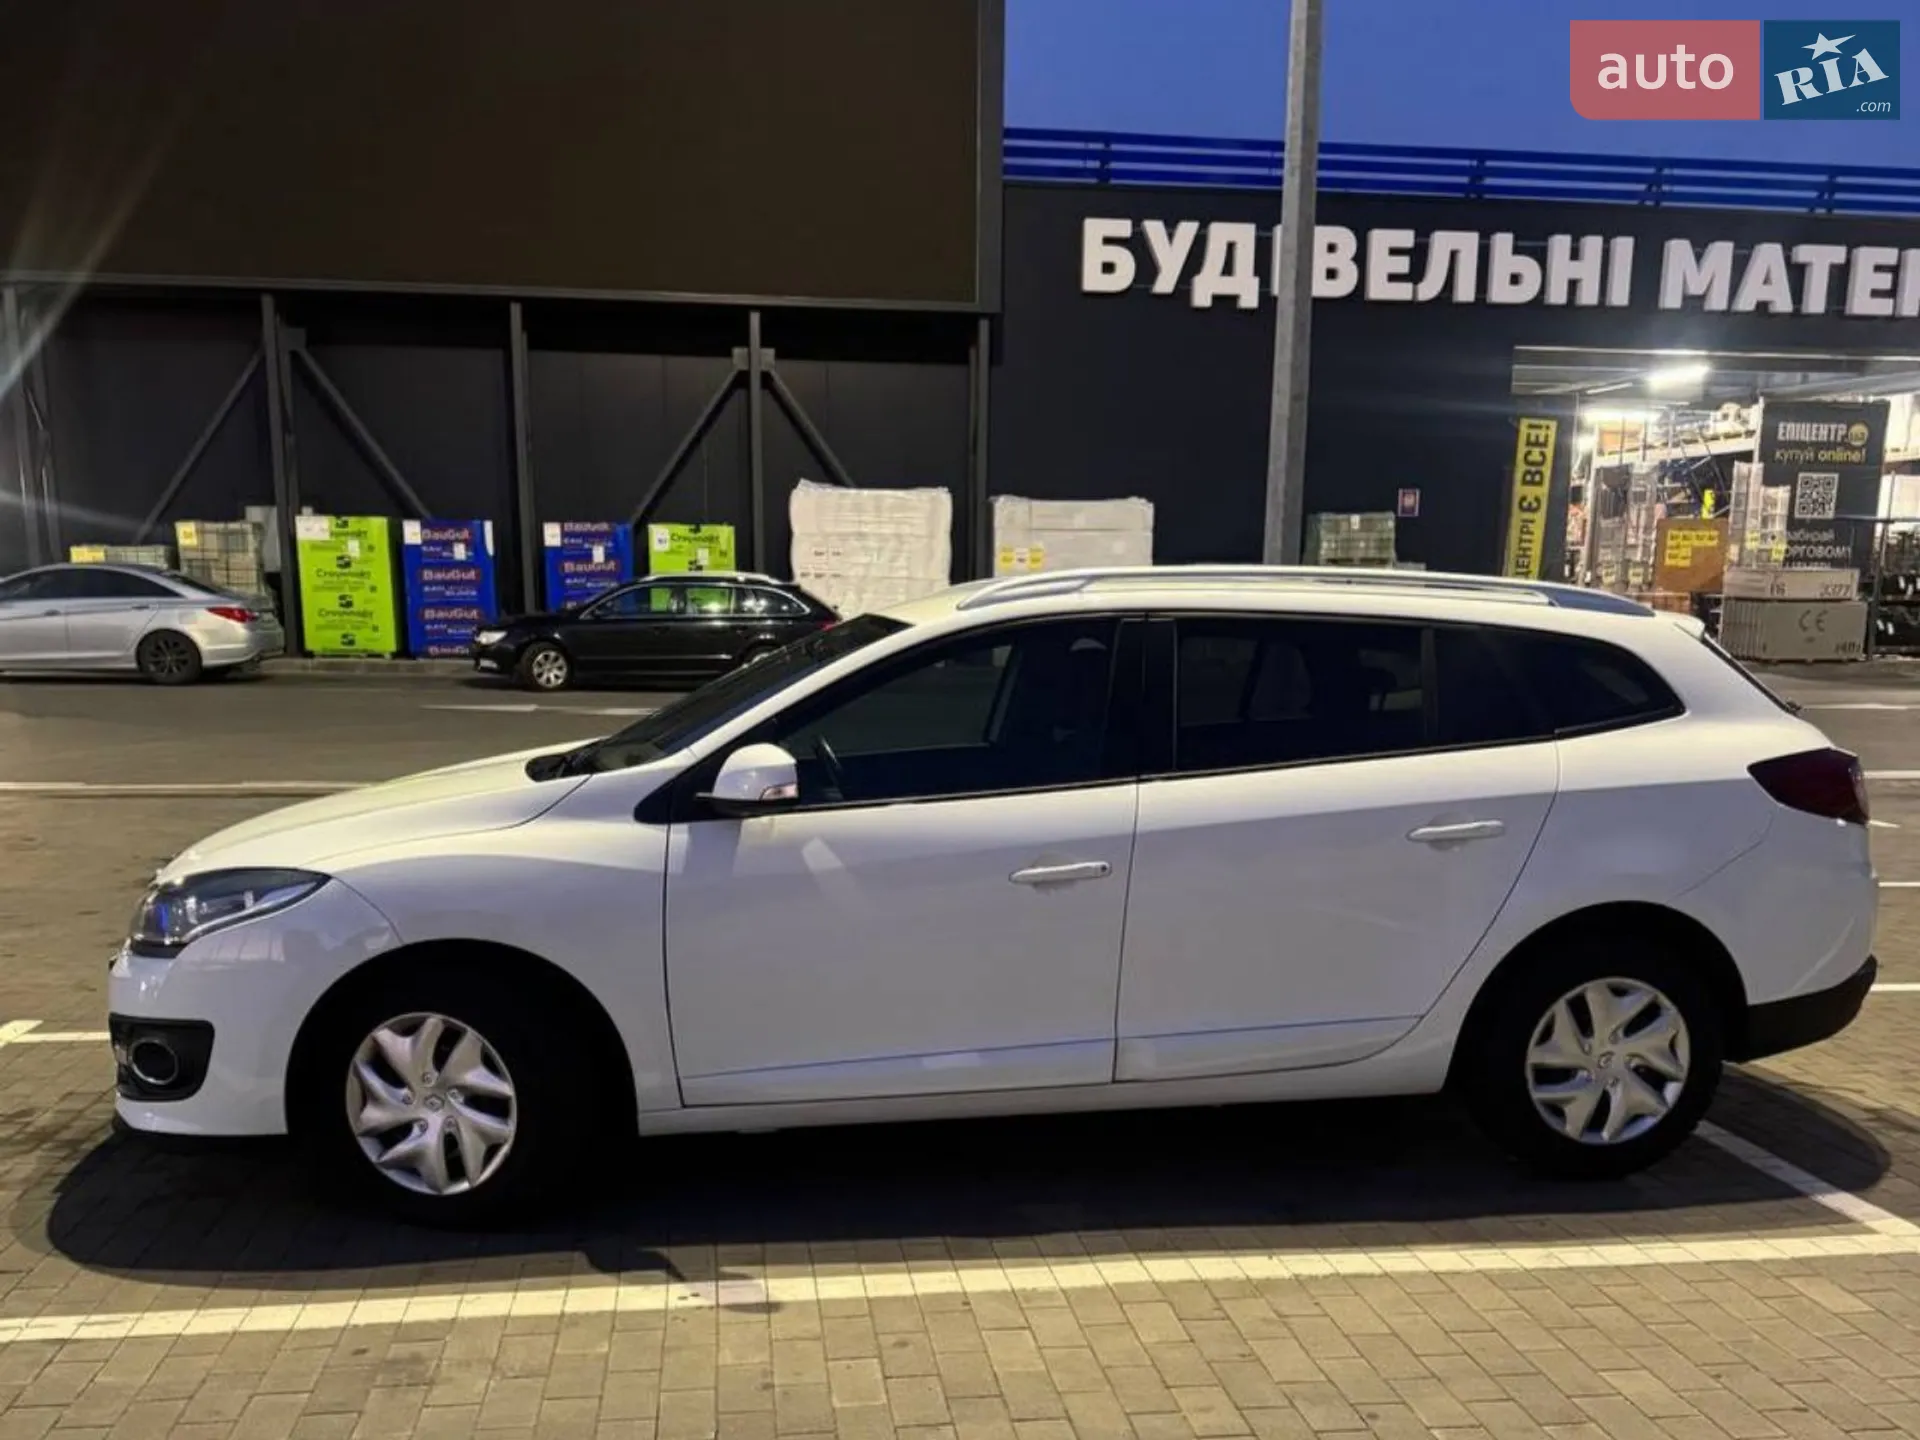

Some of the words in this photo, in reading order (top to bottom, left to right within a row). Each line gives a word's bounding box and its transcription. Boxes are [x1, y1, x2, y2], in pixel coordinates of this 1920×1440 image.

[1522, 423, 1550, 487] ВСЕ!
[1818, 447, 1866, 463] online!
[422, 568, 477, 581] BauGut
[423, 608, 479, 621] BauGut
